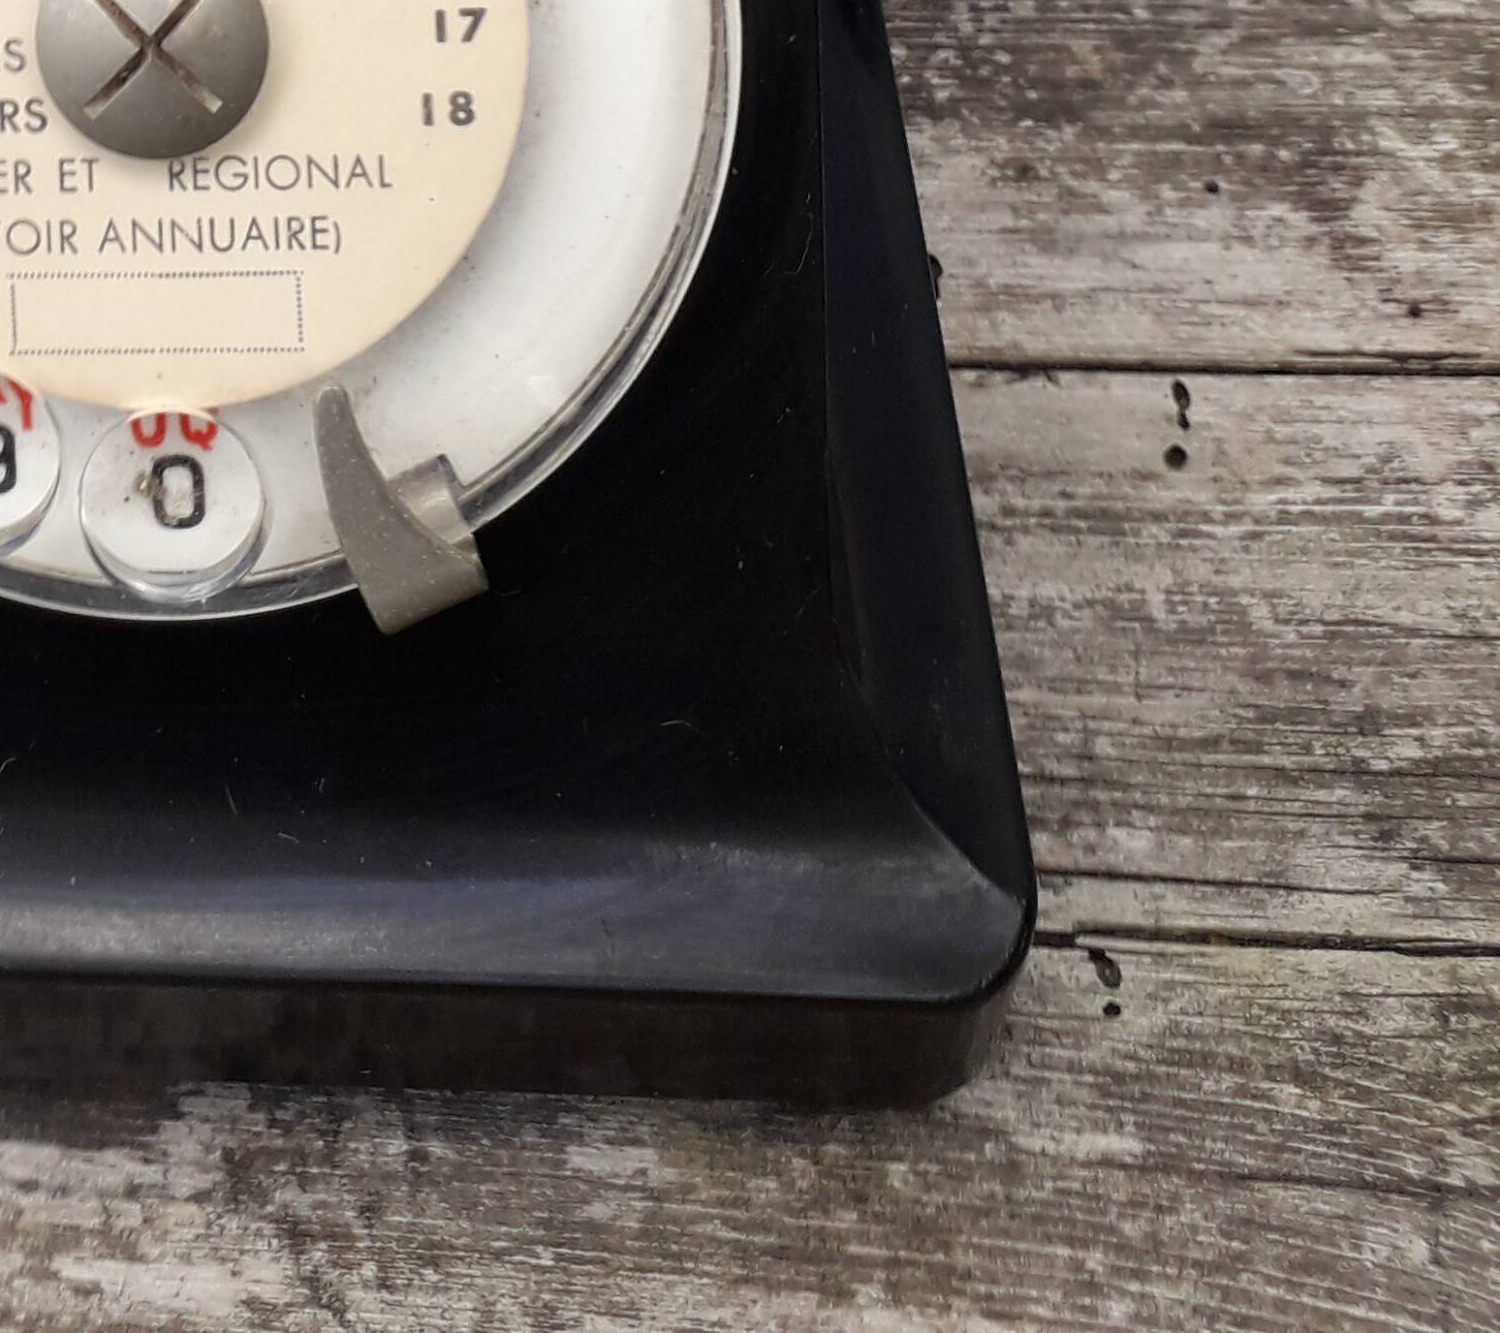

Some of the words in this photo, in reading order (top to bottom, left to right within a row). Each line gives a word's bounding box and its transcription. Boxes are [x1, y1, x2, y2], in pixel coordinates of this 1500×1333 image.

[434, 6, 488, 44] 17
[421, 90, 476, 127] 18
[58, 158, 98, 193] ET
[98, 215, 342, 255] ANNUAIRE)
[151, 454, 205, 529] 0
